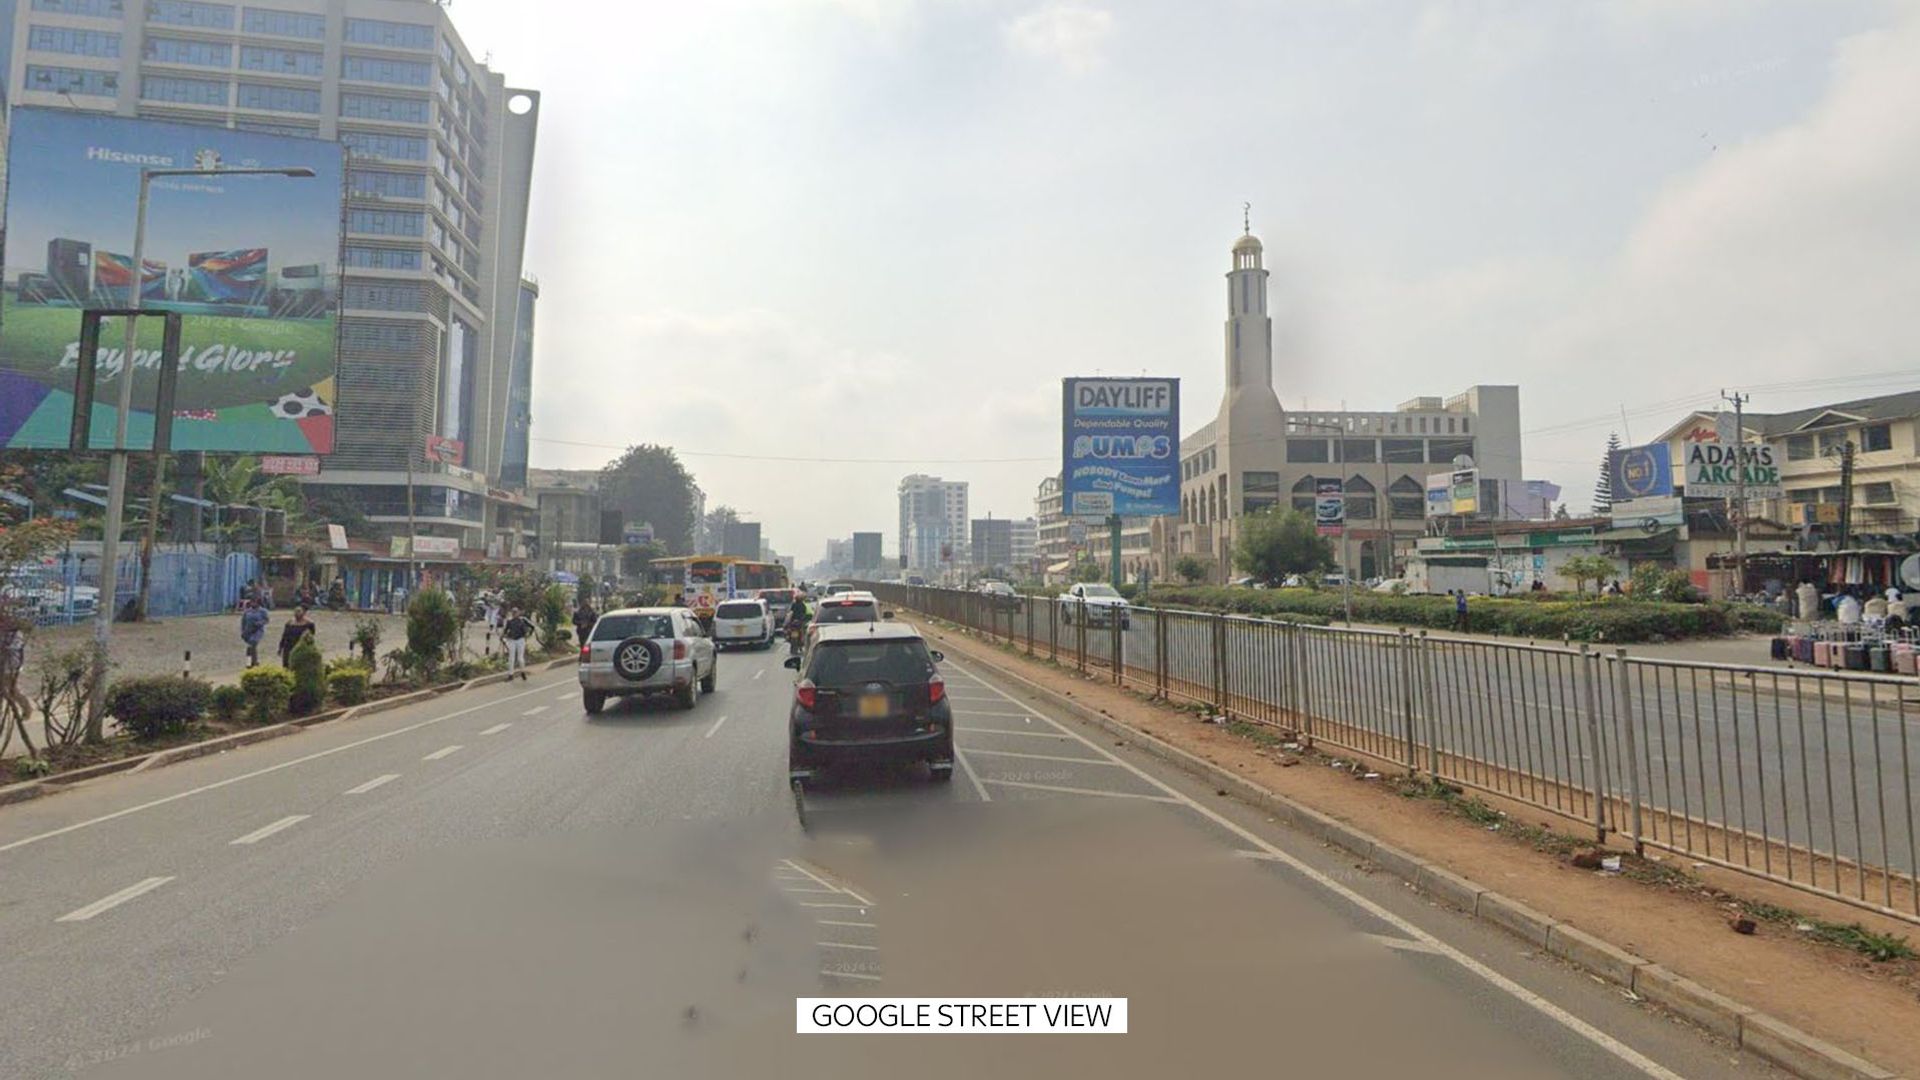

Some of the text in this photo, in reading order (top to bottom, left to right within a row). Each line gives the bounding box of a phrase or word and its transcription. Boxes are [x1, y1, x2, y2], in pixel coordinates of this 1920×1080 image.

[86, 146, 174, 168] Hisense
[1079, 386, 1167, 408] DAYLIFF
[1073, 418, 1169, 430] Dependable Quality
[1072, 435, 1171, 459] PUMPS
[1690, 444, 1773, 466] ADAMS
[1697, 465, 1779, 485] ARCADE
